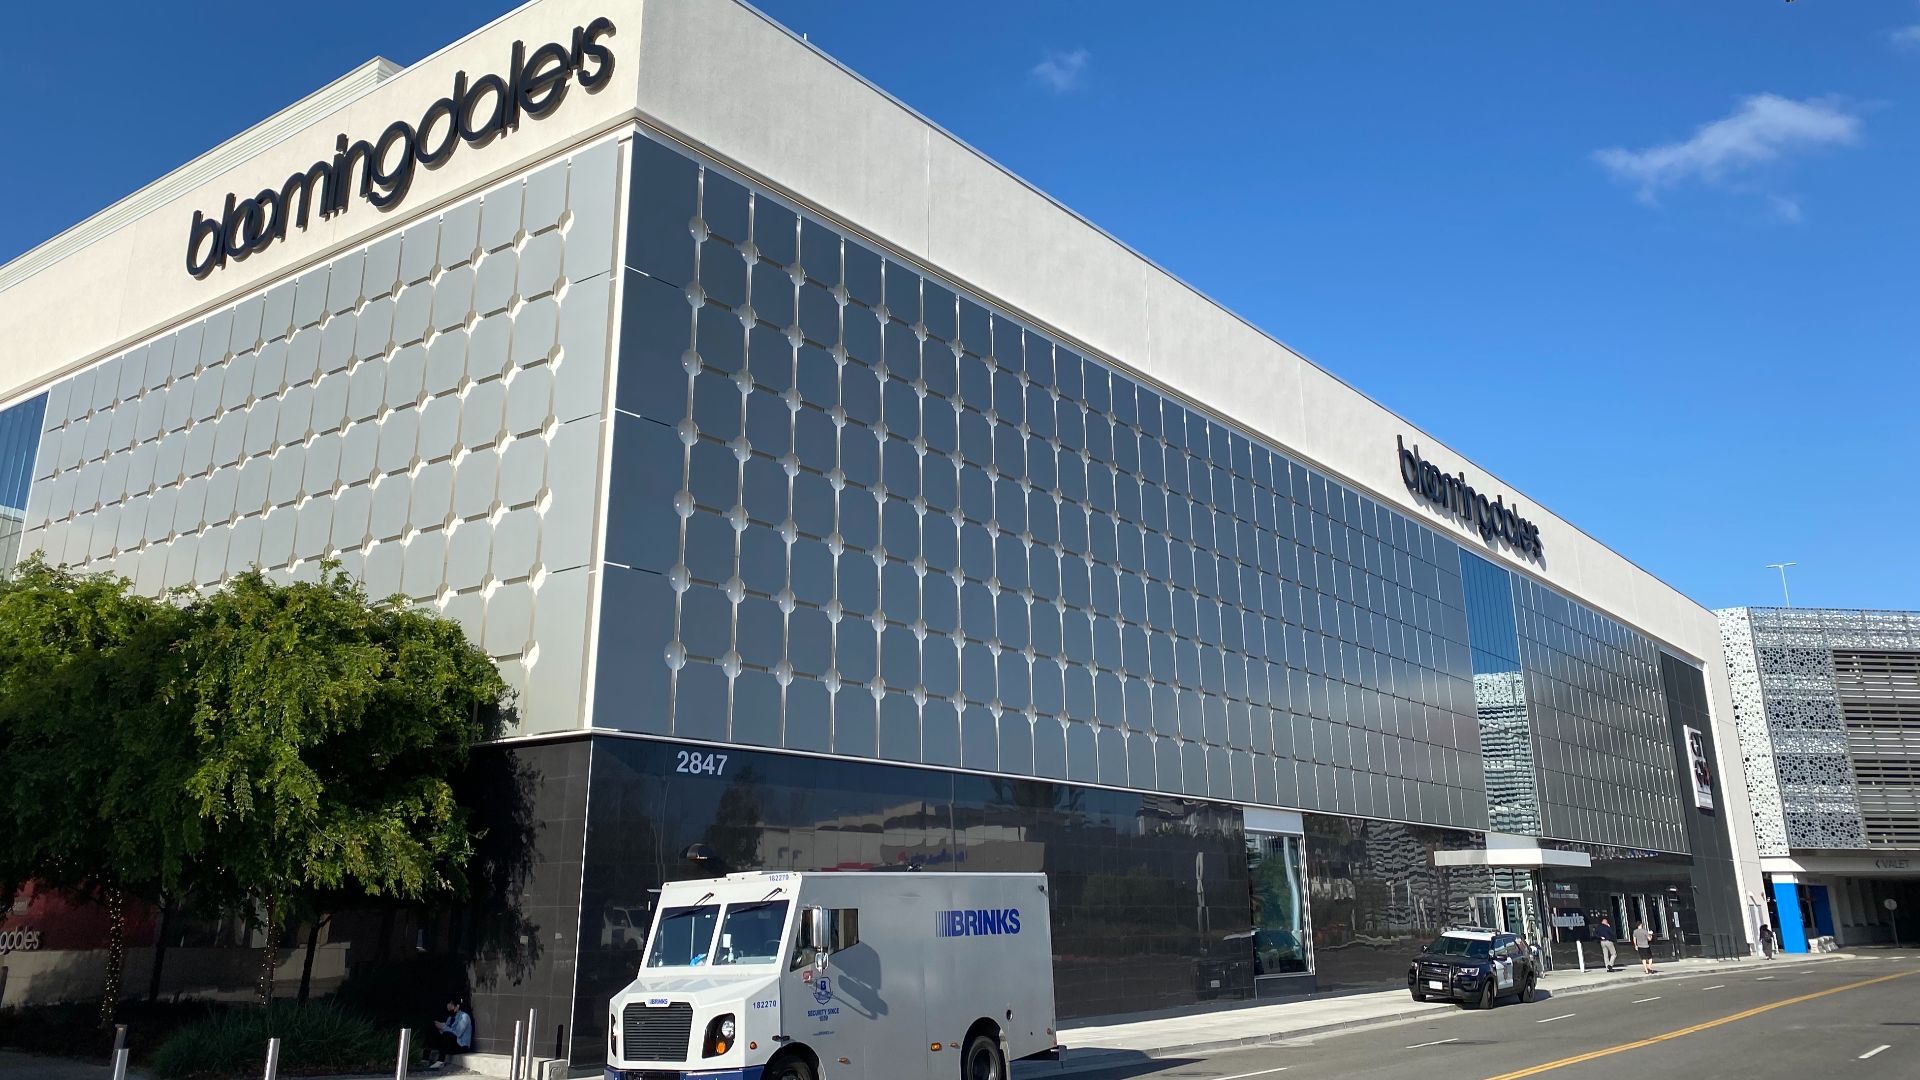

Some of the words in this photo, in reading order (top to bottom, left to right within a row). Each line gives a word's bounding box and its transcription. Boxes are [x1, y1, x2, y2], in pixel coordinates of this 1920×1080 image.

[187, 17, 616, 279] bloomingdale's
[676, 751, 727, 775] 2847
[1881, 859, 1909, 869] VALET
[950, 908, 1020, 936] BRINKS
[753, 1000, 777, 1009] 182270
[808, 1009, 827, 1017] SECURITY
